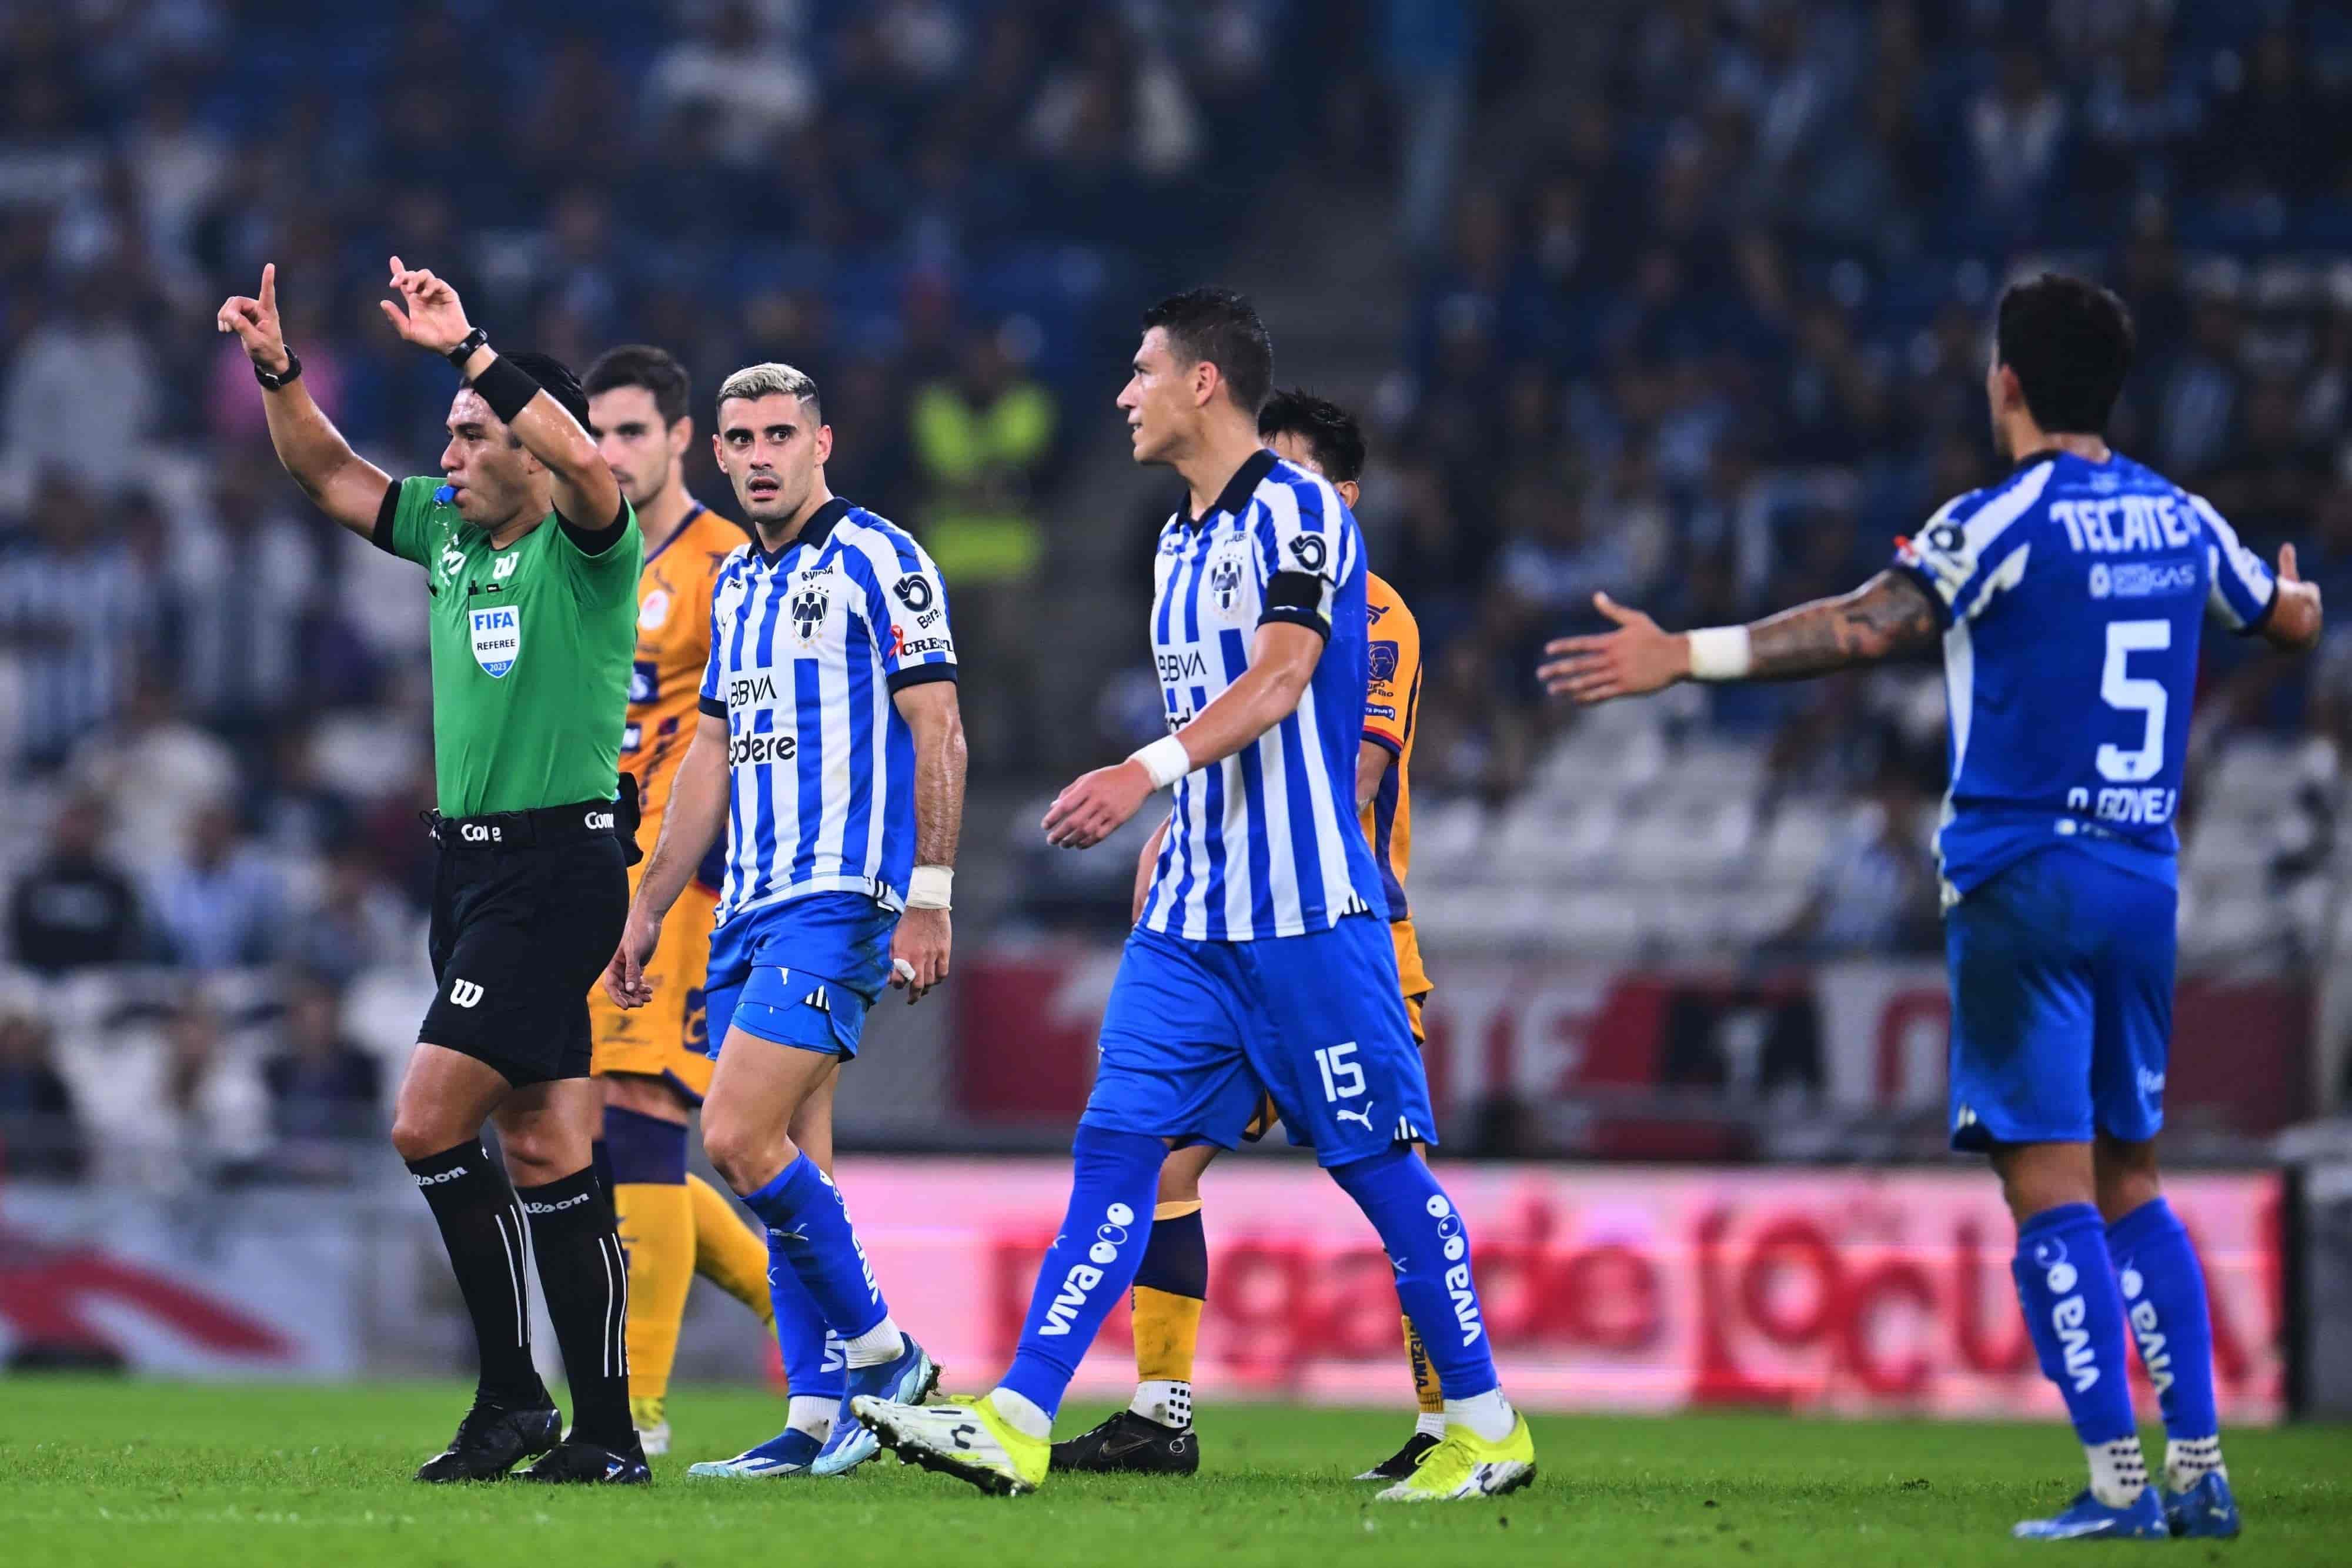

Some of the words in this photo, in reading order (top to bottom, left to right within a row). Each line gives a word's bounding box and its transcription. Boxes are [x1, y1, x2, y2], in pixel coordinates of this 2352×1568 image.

[2049, 494, 2190, 553] TECATE
[474, 611, 514, 630] FIFA
[476, 638, 516, 651] REFEREE
[489, 662, 507, 672] 2023
[1158, 650, 1207, 683] BBVA
[731, 674, 777, 708] BBVA
[2095, 619, 2171, 782] 5
[1314, 1041, 1367, 1103] 15
